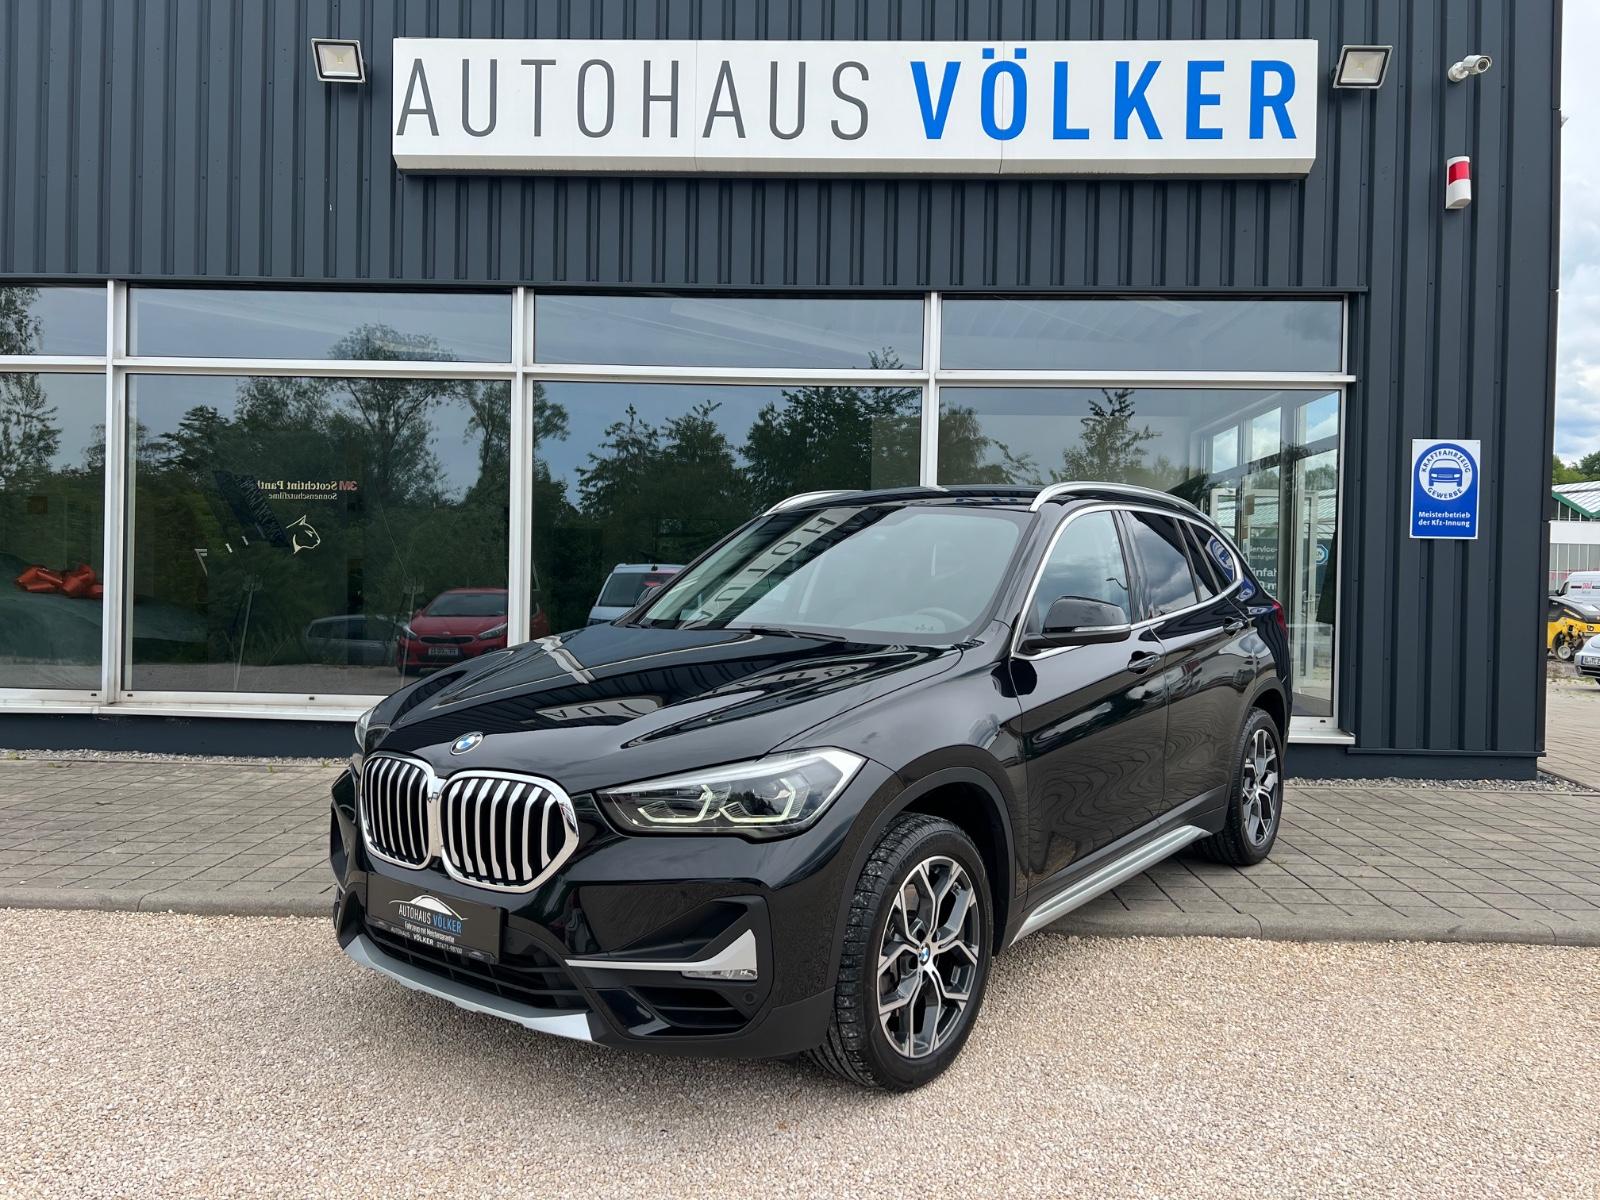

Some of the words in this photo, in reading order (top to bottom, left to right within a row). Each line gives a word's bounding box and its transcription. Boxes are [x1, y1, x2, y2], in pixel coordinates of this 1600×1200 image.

[396, 58, 870, 141] AUTOHAUS
[911, 47, 1296, 141] VÖLKER
[1421, 449, 1471, 473] KRAFTFAHRZEUG
[1427, 486, 1463, 499] GEWERBE
[1418, 511, 1471, 519] Meisterbetrieb
[1431, 519, 1470, 528] Kfz-Innung
[399, 904, 431, 924] AUTOHAUS
[432, 913, 462, 934] VÖLKER
